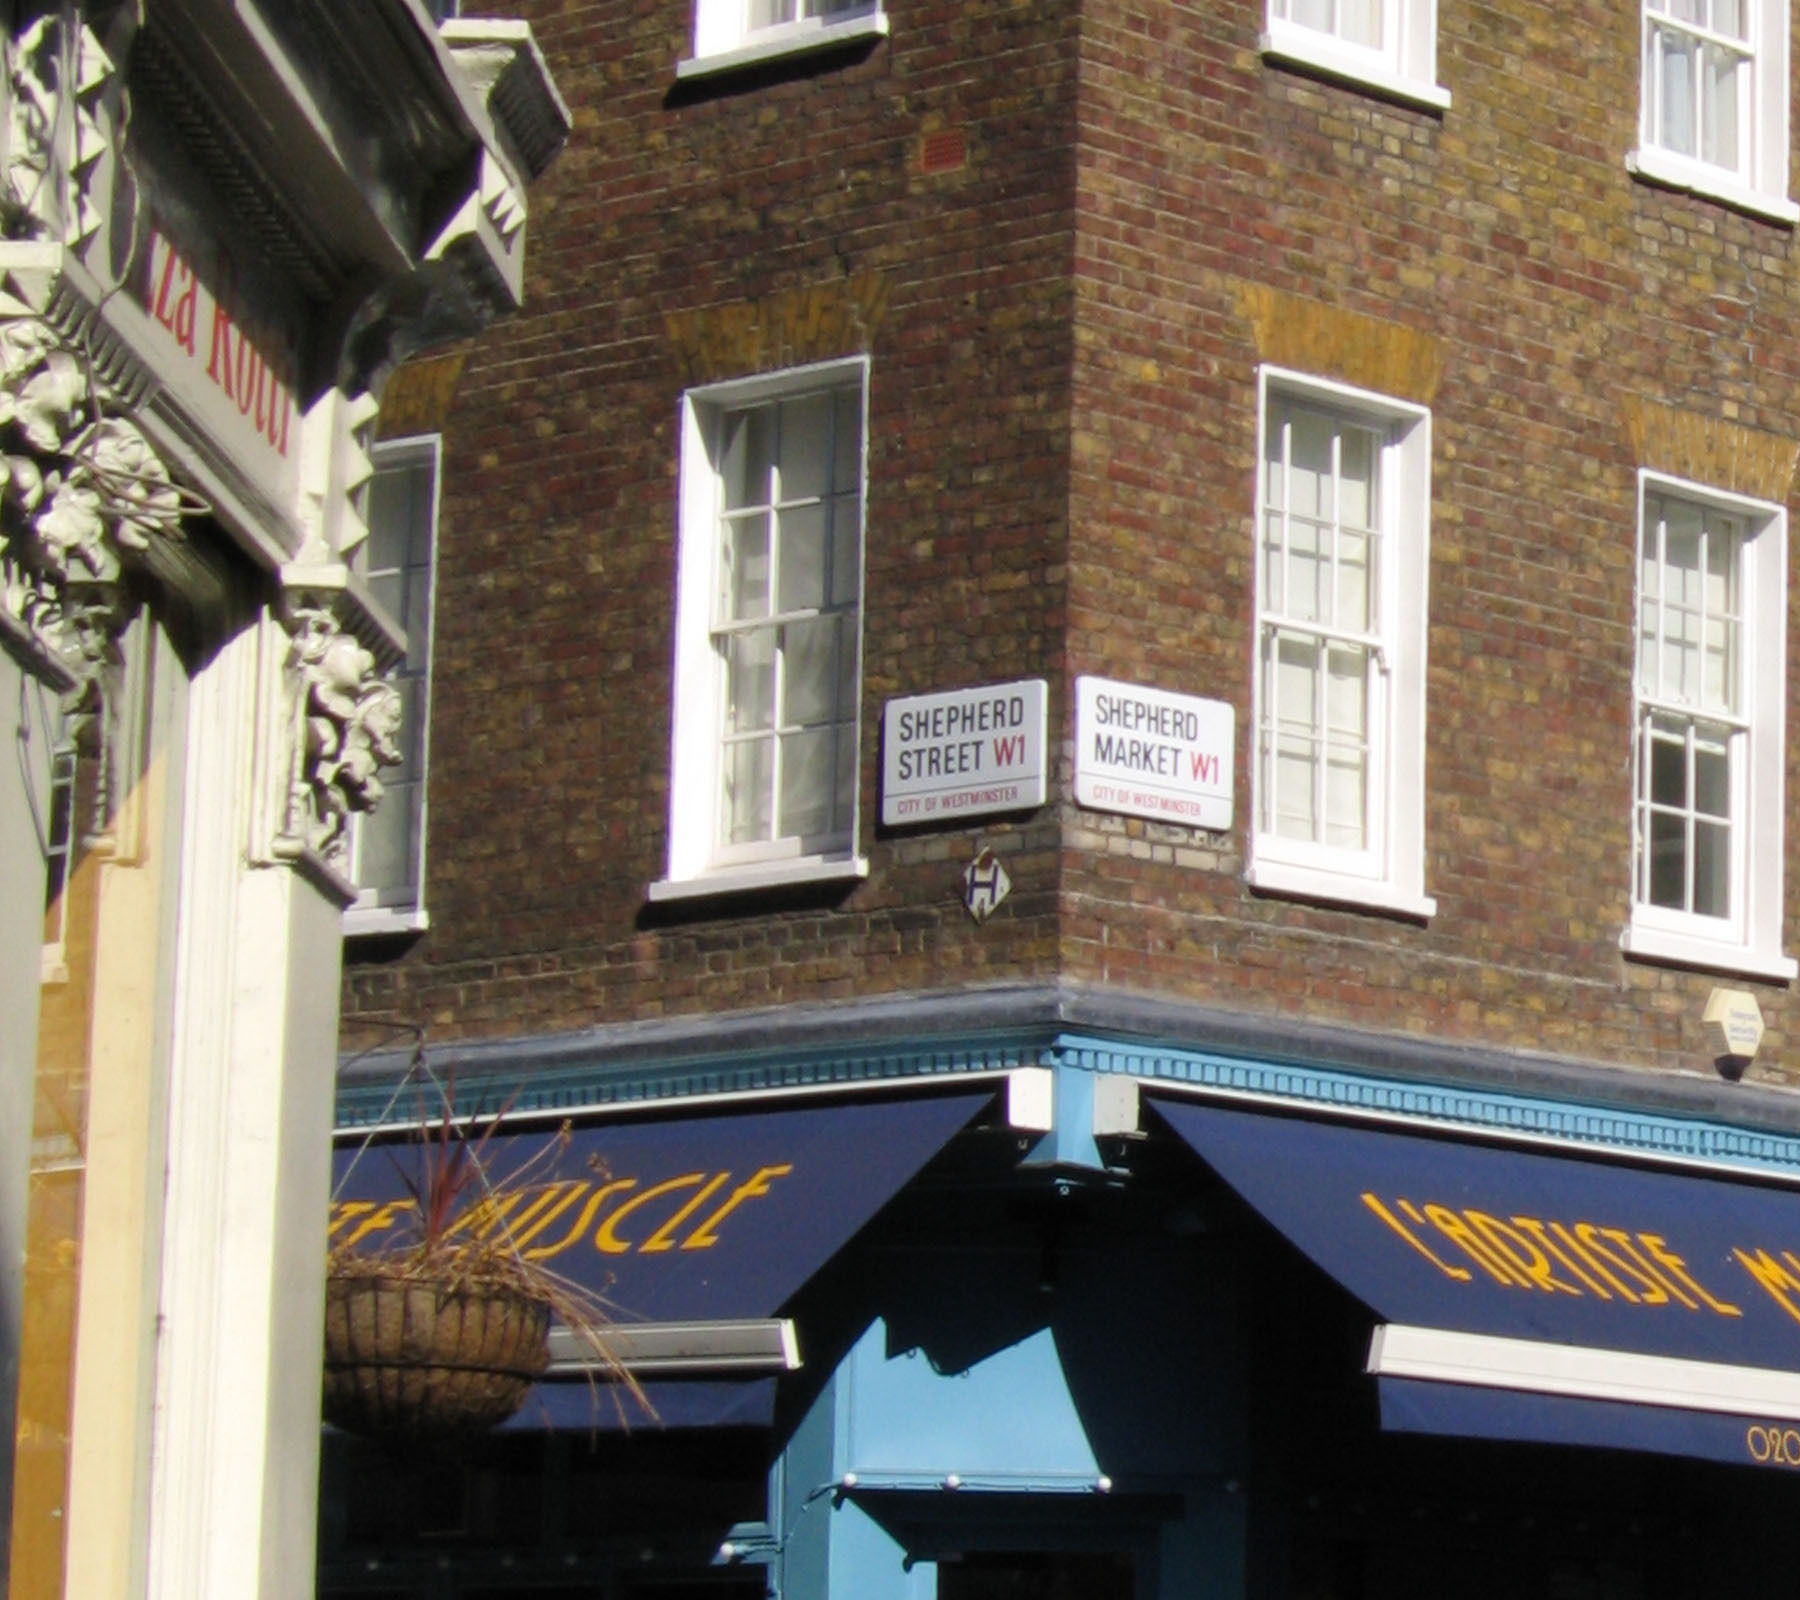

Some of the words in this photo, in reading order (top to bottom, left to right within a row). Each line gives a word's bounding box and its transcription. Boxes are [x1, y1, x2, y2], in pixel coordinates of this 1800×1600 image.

[900, 696, 1024, 742] SHEPHERD
[1095, 694, 1199, 741] SHEPHERD
[898, 740, 985, 781] STREET
[993, 735, 1026, 767] W1
[1094, 733, 1182, 777] MARKET
[1190, 754, 1219, 785] W1
[897, 798, 921, 815] CITY
[925, 797, 937, 812] OF
[941, 786, 1018, 809] WESTMINSTER
[1093, 785, 1115, 802] CITY
[1118, 789, 1129, 804] OF
[1132, 792, 1202, 817] WESTMINSTER
[1361, 1192, 1743, 1318] L'ARTISTE
